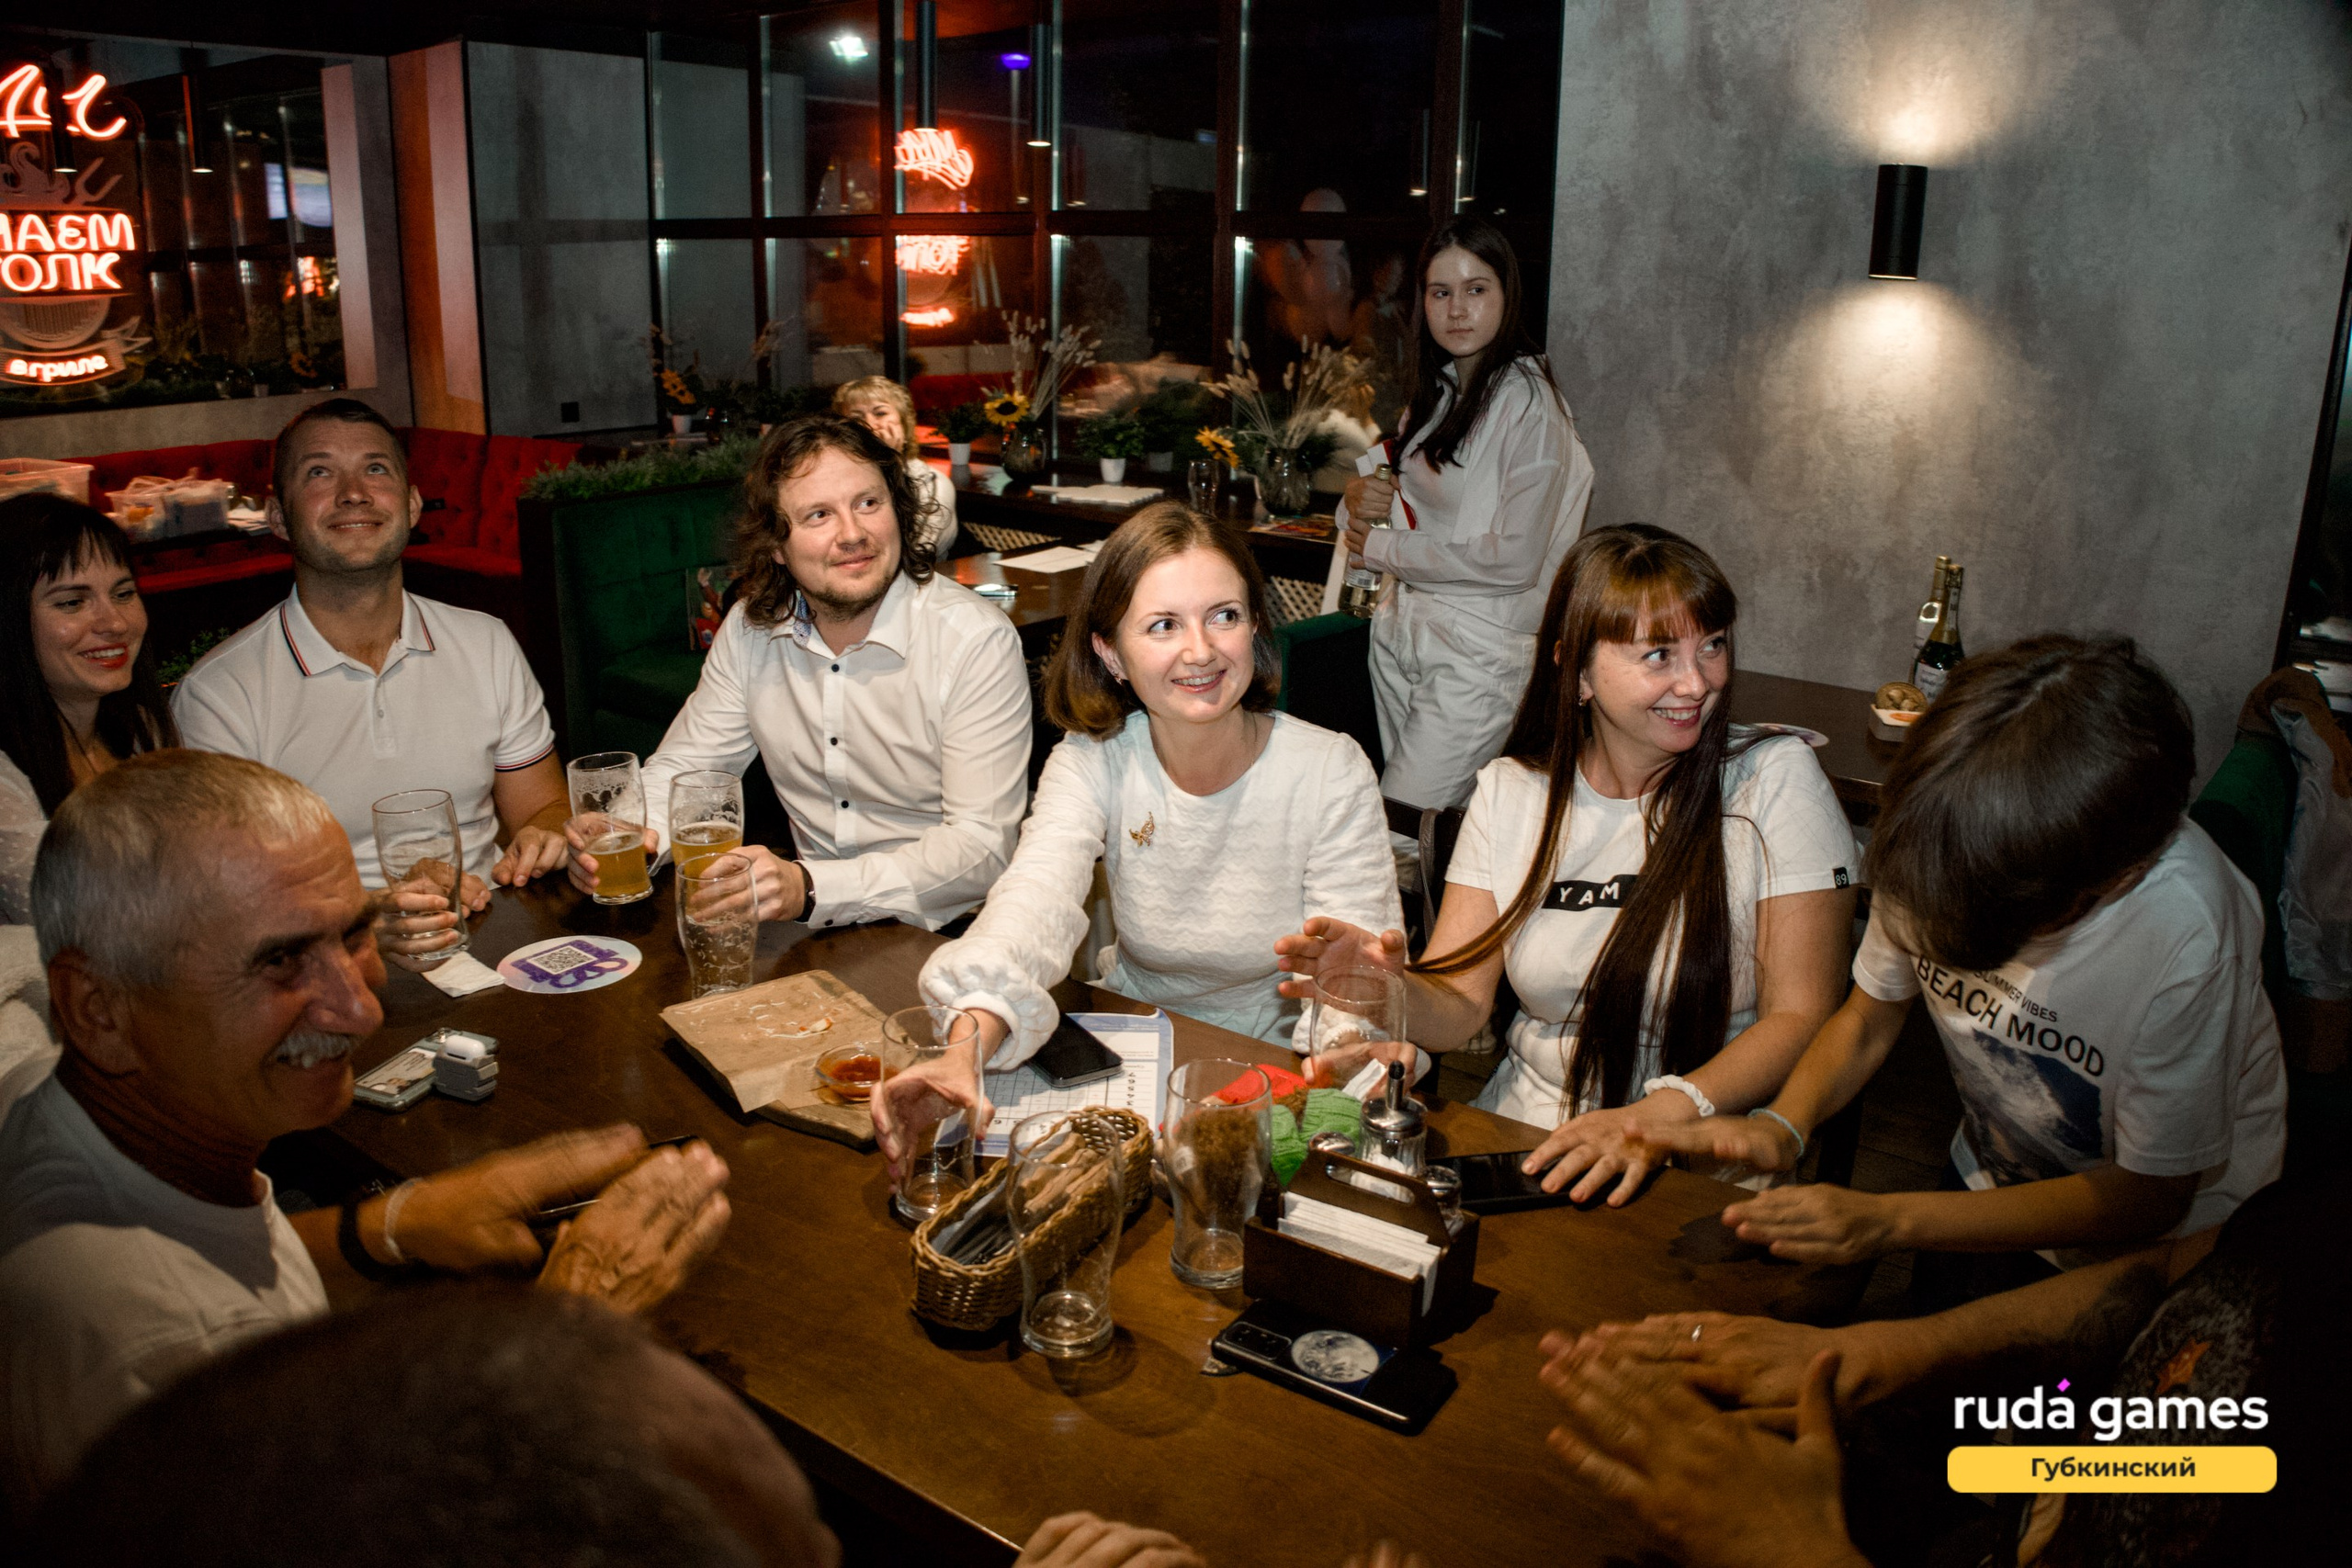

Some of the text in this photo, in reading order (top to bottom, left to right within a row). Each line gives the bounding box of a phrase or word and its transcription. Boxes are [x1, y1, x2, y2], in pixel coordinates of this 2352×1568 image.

[0, 252, 122, 292] ОЛК
[1836, 874, 1847, 886] 89
[1917, 955, 2105, 1077] BEACH MOOD
[2021, 996, 2058, 1022] VIBES
